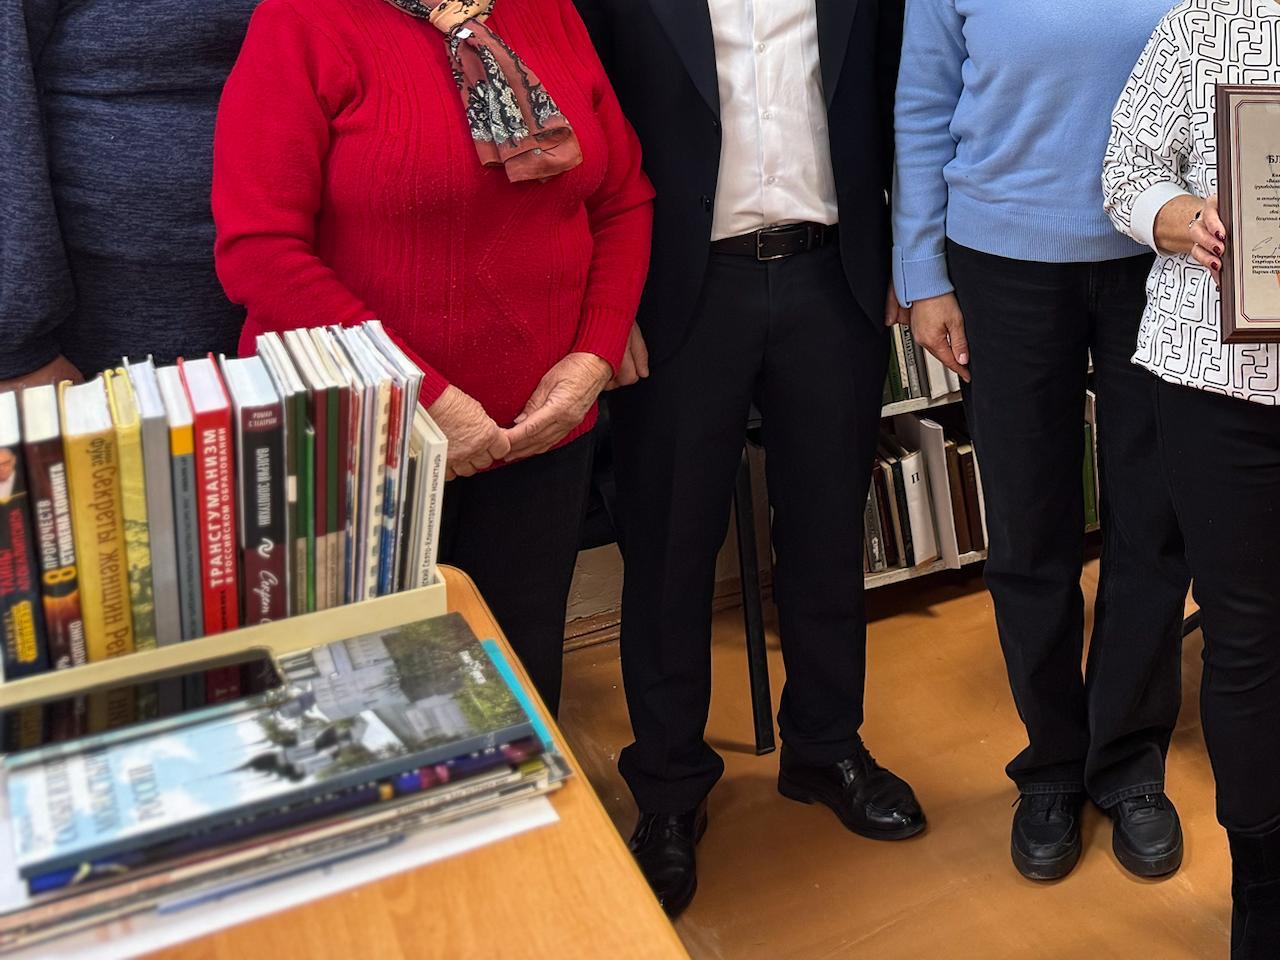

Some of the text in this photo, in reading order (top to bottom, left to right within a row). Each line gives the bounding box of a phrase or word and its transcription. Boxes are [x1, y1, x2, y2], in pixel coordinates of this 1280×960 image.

[218, 428, 229, 500] ОБРАЗОВАНИИ
[36, 499, 58, 569] ПРОРОЧЕСТВ
[49, 462, 75, 566] СТИВЕНА ХОКИНГА
[203, 429, 223, 587] ТРАНСГУМАНИЗМ
[222, 504, 234, 573] РОССИЙСКОМ
[43, 566, 77, 585] 8
[90, 465, 124, 625] Секреты женщин
